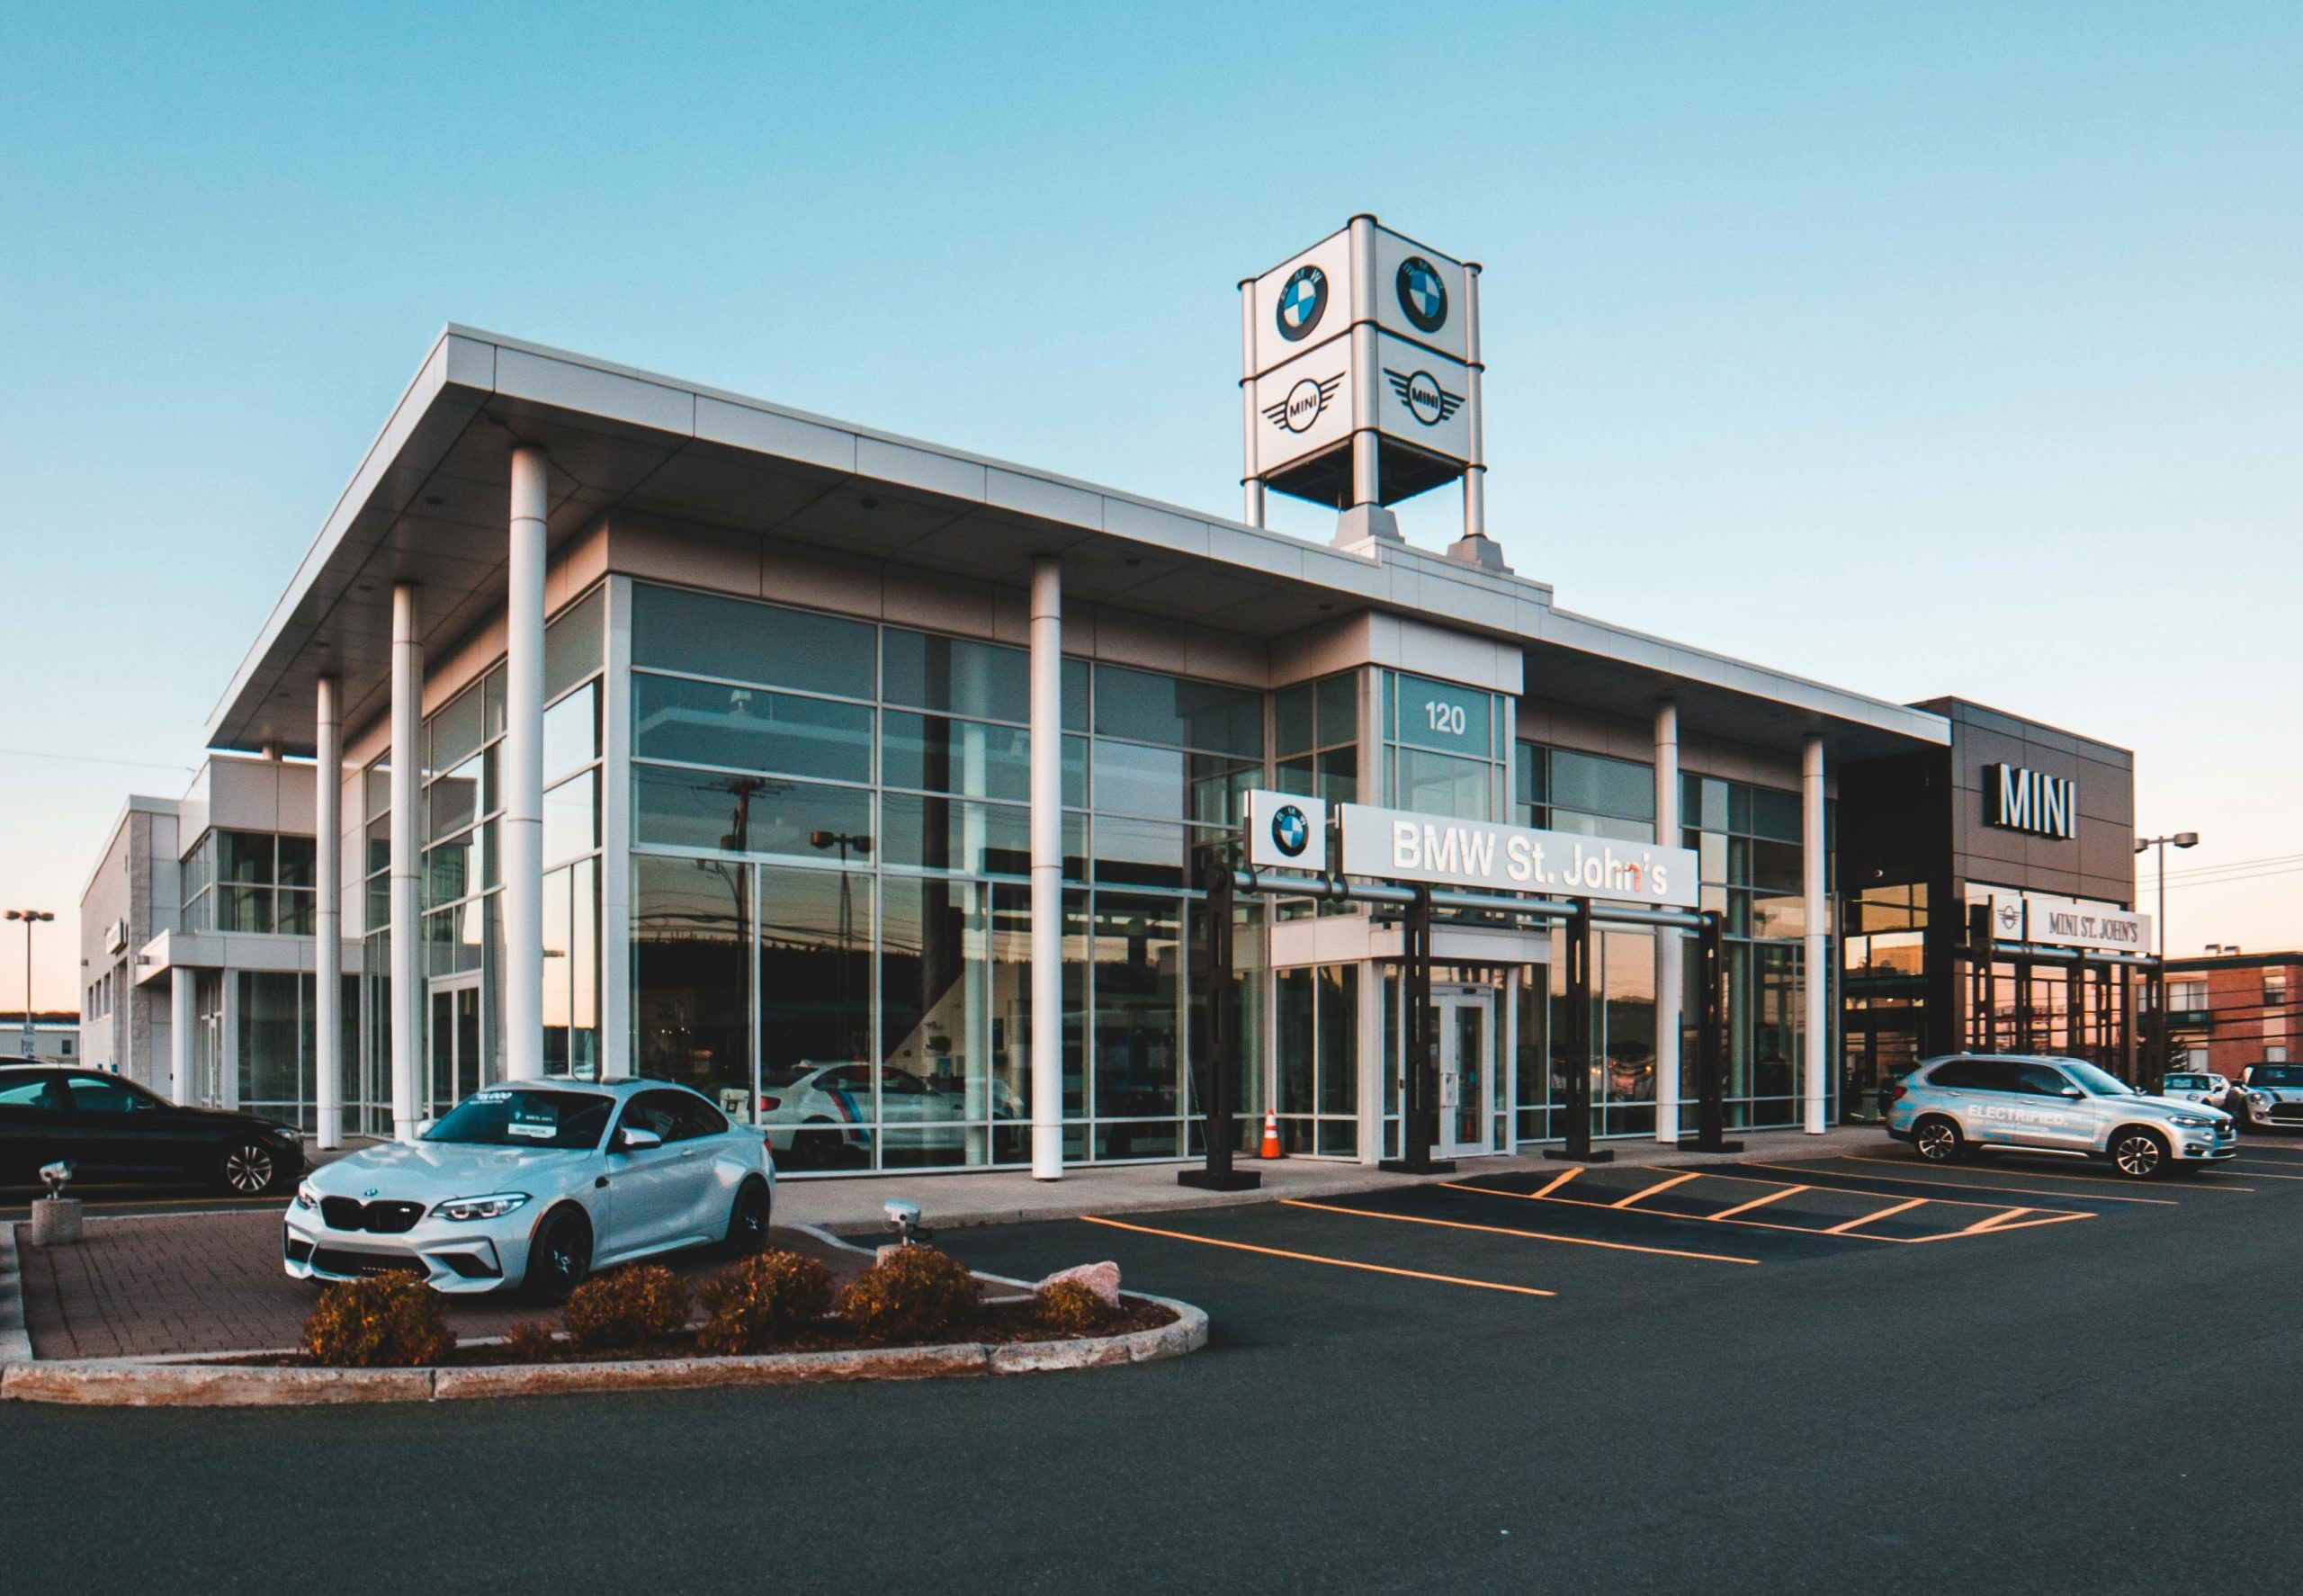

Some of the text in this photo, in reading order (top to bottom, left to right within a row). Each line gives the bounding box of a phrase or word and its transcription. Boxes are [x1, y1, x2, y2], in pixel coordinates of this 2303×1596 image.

[1289, 393, 1317, 417] MINI
[1411, 387, 1438, 409] MINI
[1425, 701, 1465, 735] 120
[1276, 806, 1307, 826] BMW
[1998, 762, 2075, 838] MINI
[1392, 820, 1669, 896] BMW St. John's
[2048, 911, 2138, 943] MINI ST. JOHN'S
